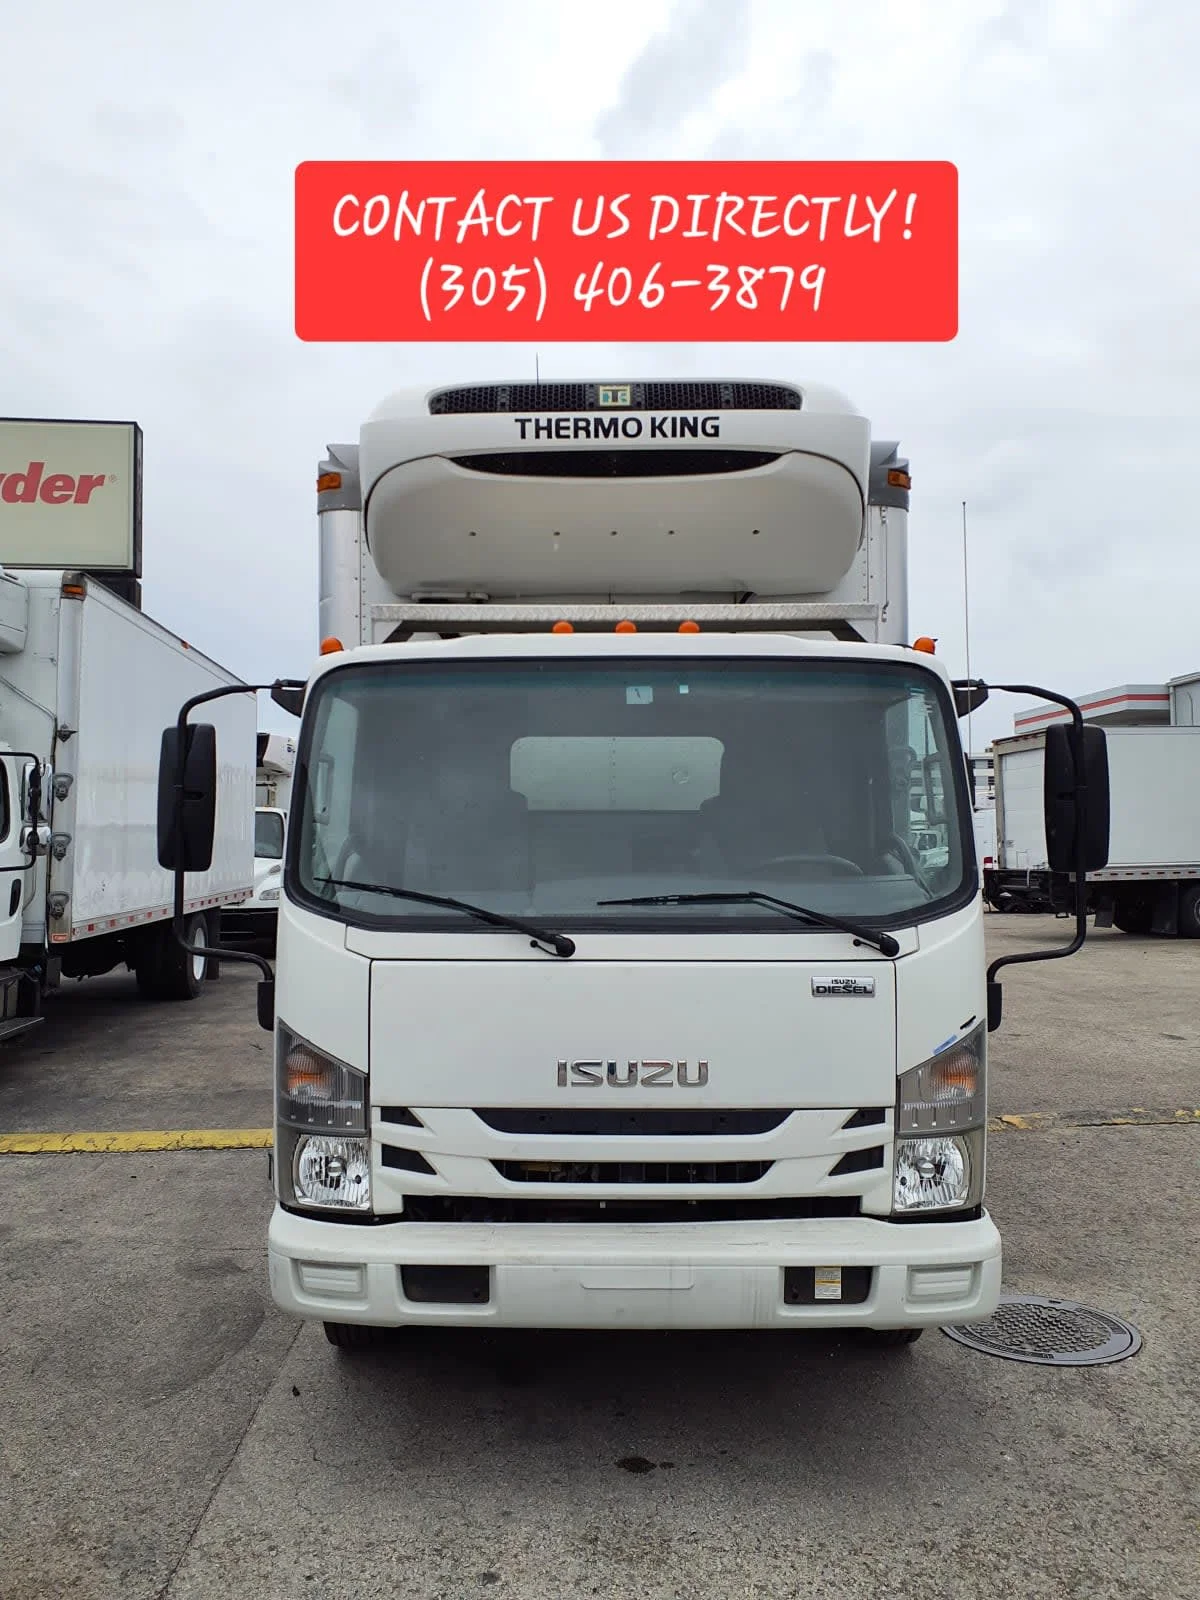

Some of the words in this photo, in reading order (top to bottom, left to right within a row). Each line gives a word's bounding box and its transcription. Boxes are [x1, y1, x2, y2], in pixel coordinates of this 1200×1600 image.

[514, 417, 643, 440] THERMO
[650, 416, 720, 439] KING
[815, 985, 873, 994] DIESEL
[557, 1059, 709, 1088] ISUZU
